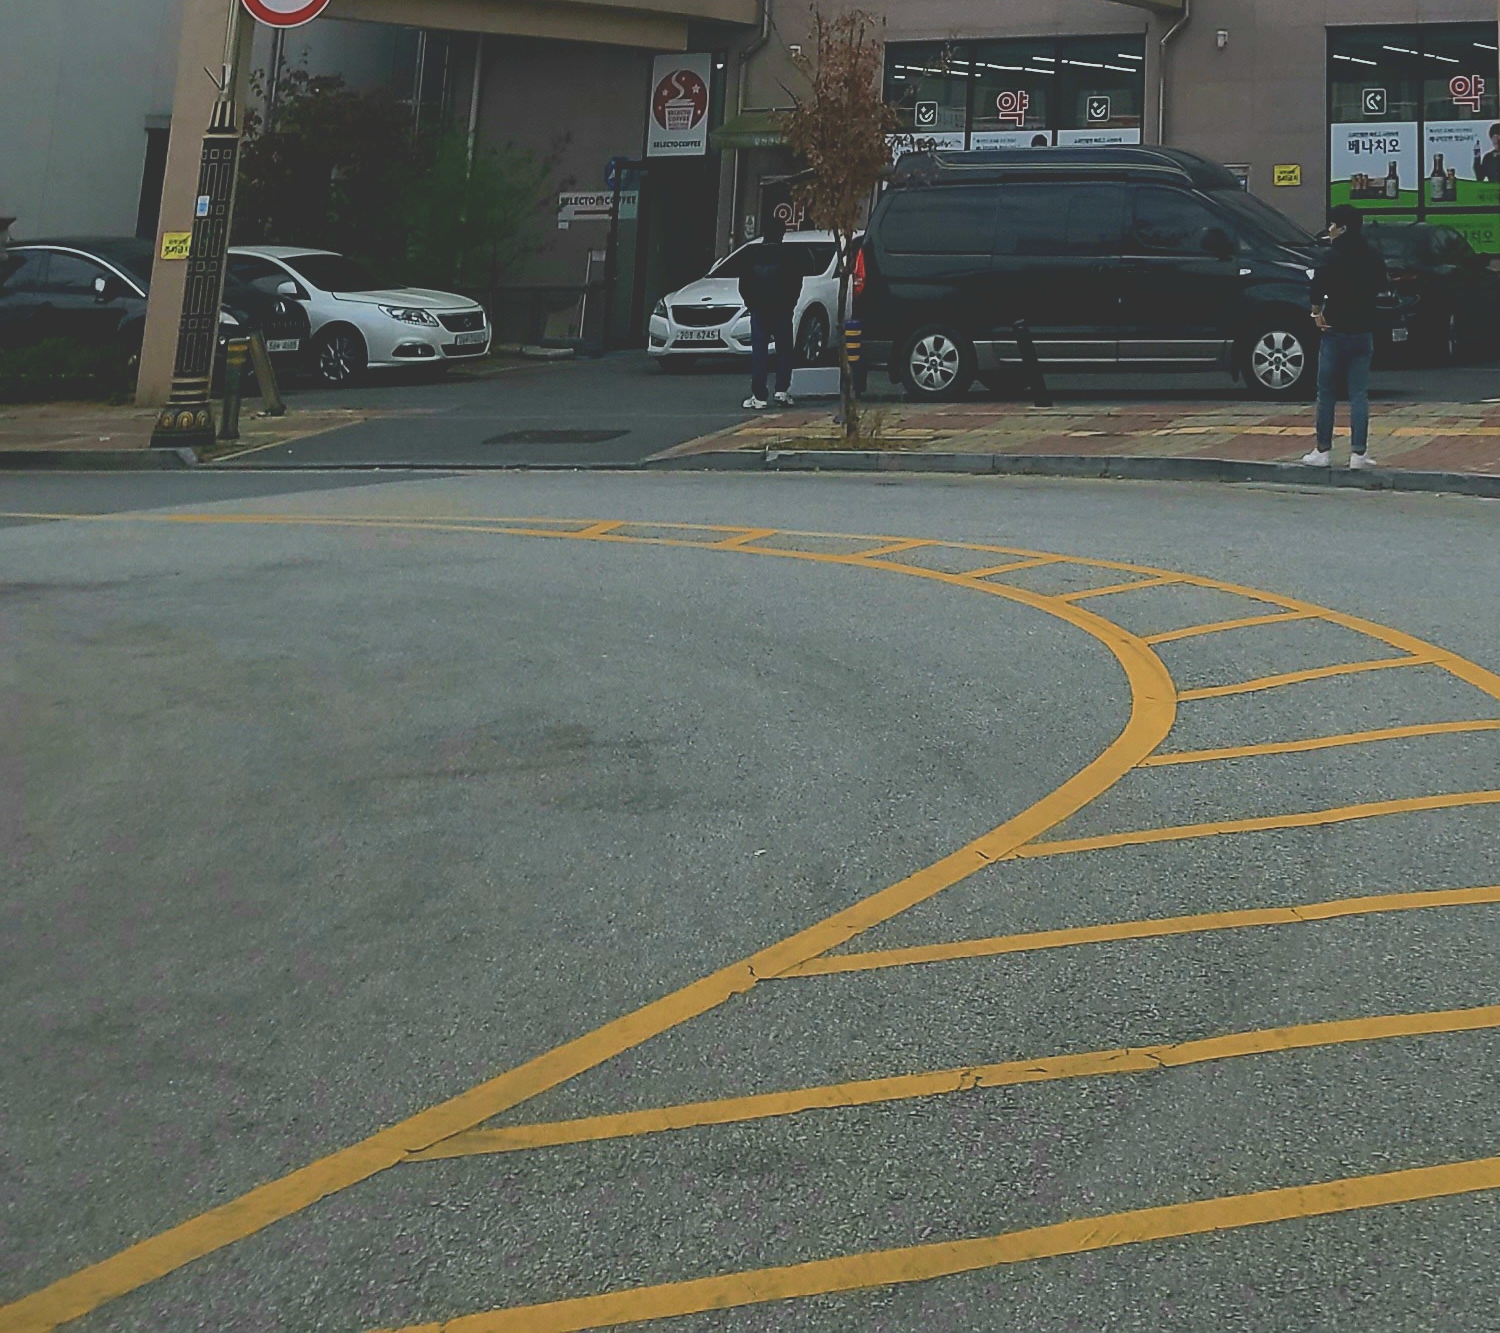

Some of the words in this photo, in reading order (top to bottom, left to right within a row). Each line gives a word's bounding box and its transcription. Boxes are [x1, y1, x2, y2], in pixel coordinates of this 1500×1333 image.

[997, 90, 1029, 127] 약
[1450, 75, 1485, 112] 약
[1348, 138, 1401, 155] 베나치오
